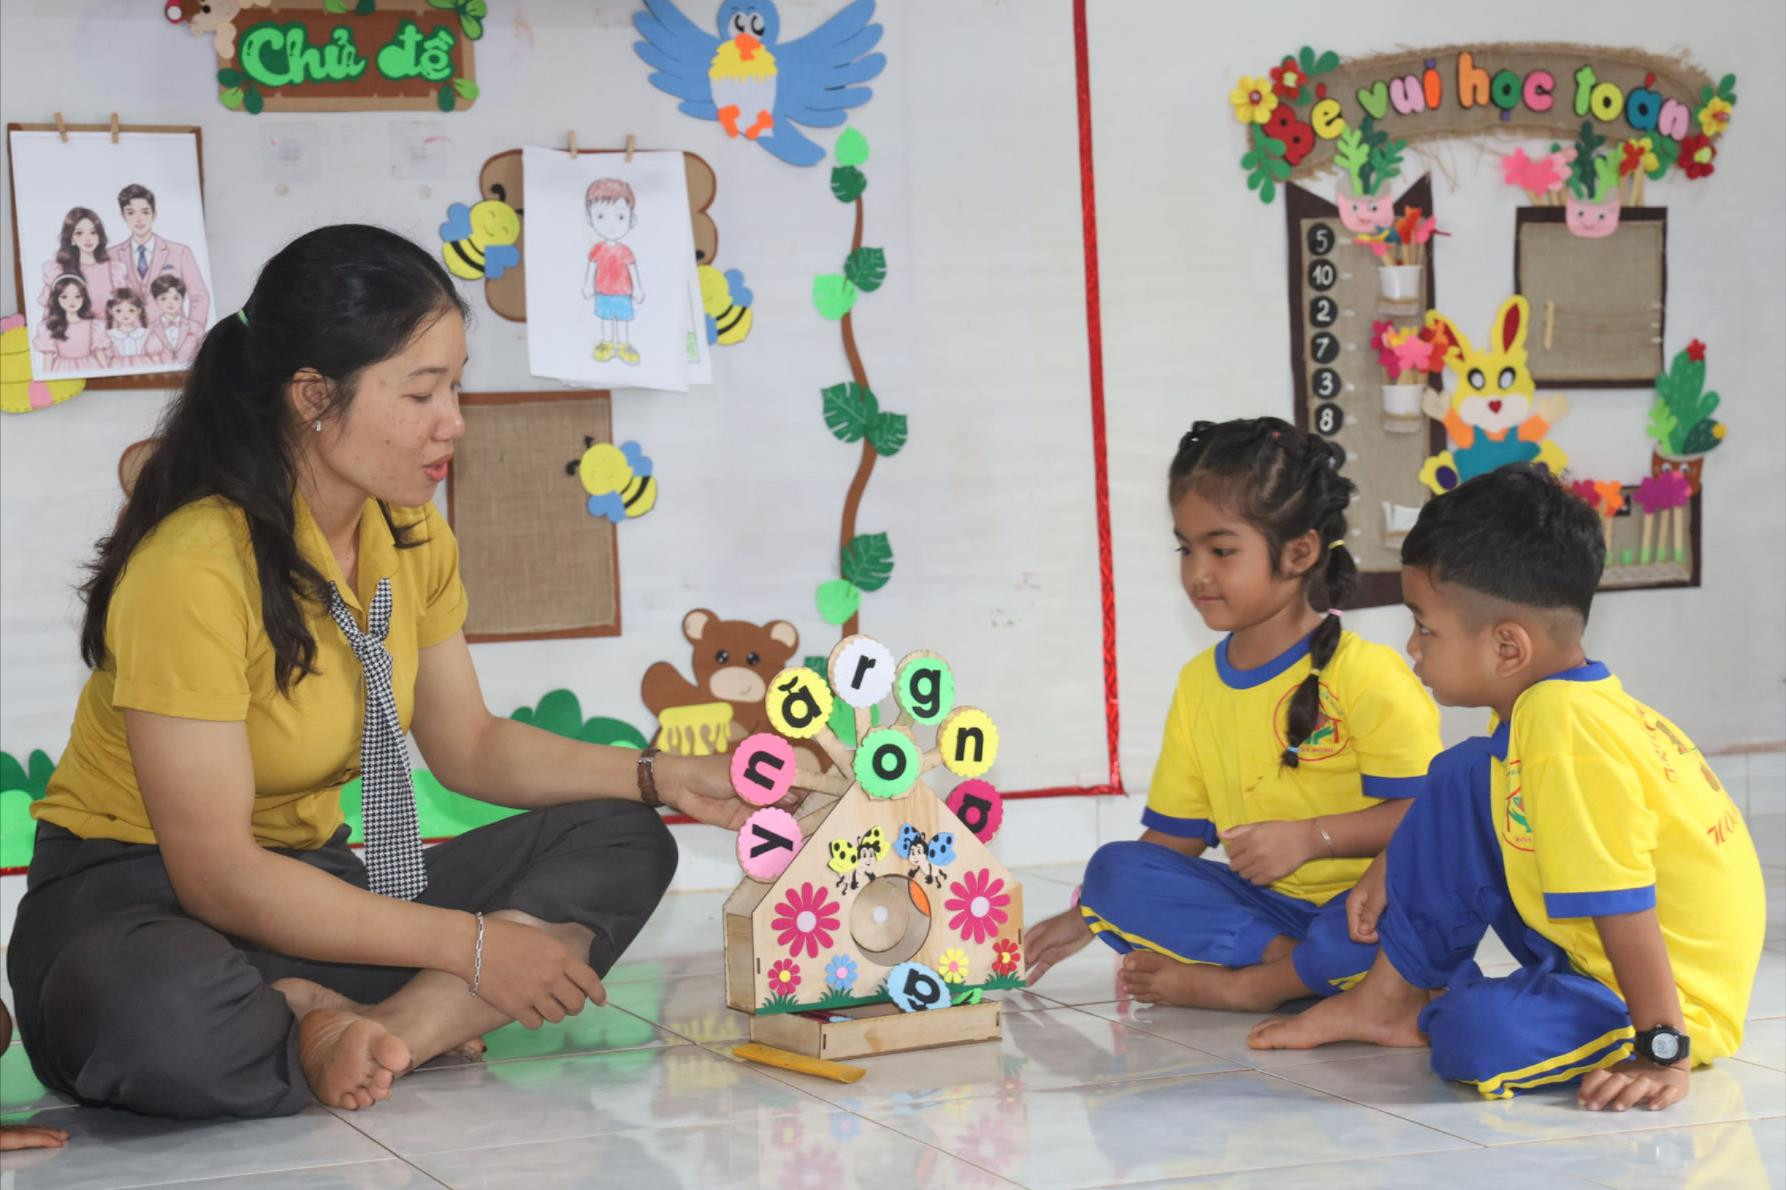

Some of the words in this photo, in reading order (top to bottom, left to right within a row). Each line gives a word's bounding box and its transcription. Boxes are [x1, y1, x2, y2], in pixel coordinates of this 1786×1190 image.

[241, 27, 366, 86] Chủ
[377, 24, 454, 80] đề
[1355, 58, 1442, 121] vui
[1458, 51, 1557, 122] học
[1574, 65, 1691, 141] toán
[1315, 230, 1328, 252] 5
[1312, 265, 1333, 286] 10
[1316, 302, 1331, 323] 2
[1316, 340, 1330, 359] 7
[1318, 372, 1333, 396] 3
[1319, 409, 1336, 432] 8
[851, 654, 876, 690] r
[909, 668, 942, 719] g
[872, 743, 907, 781] o
[954, 727, 984, 762] n
[750, 823, 794, 859] y
